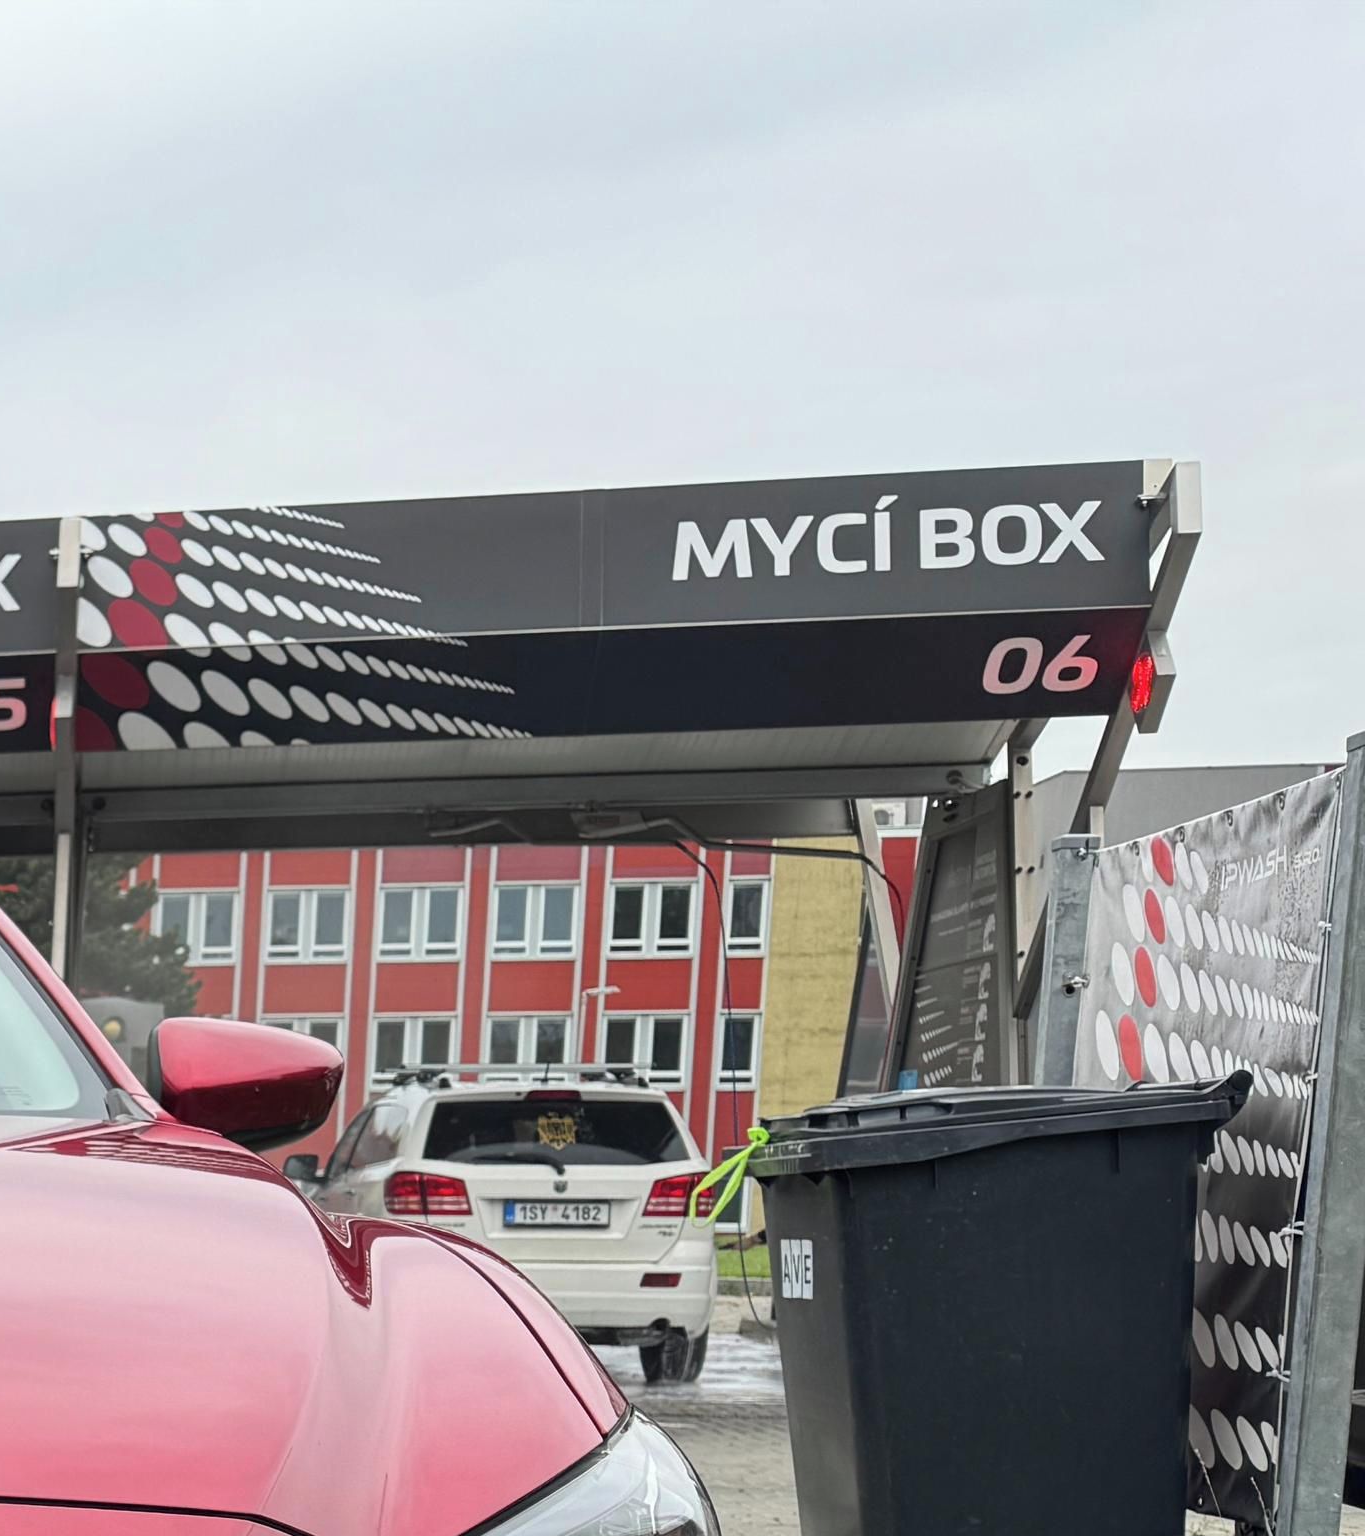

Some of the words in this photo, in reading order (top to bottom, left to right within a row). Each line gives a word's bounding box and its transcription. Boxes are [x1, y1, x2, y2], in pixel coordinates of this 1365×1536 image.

[672, 495, 898, 581] MYCÍ
[919, 500, 1105, 569] BOX
[982, 635, 1099, 695] 06
[519, 1205, 548, 1221] 1SY
[561, 1204, 601, 1221] 4182
[783, 1254, 811, 1285] AVE
